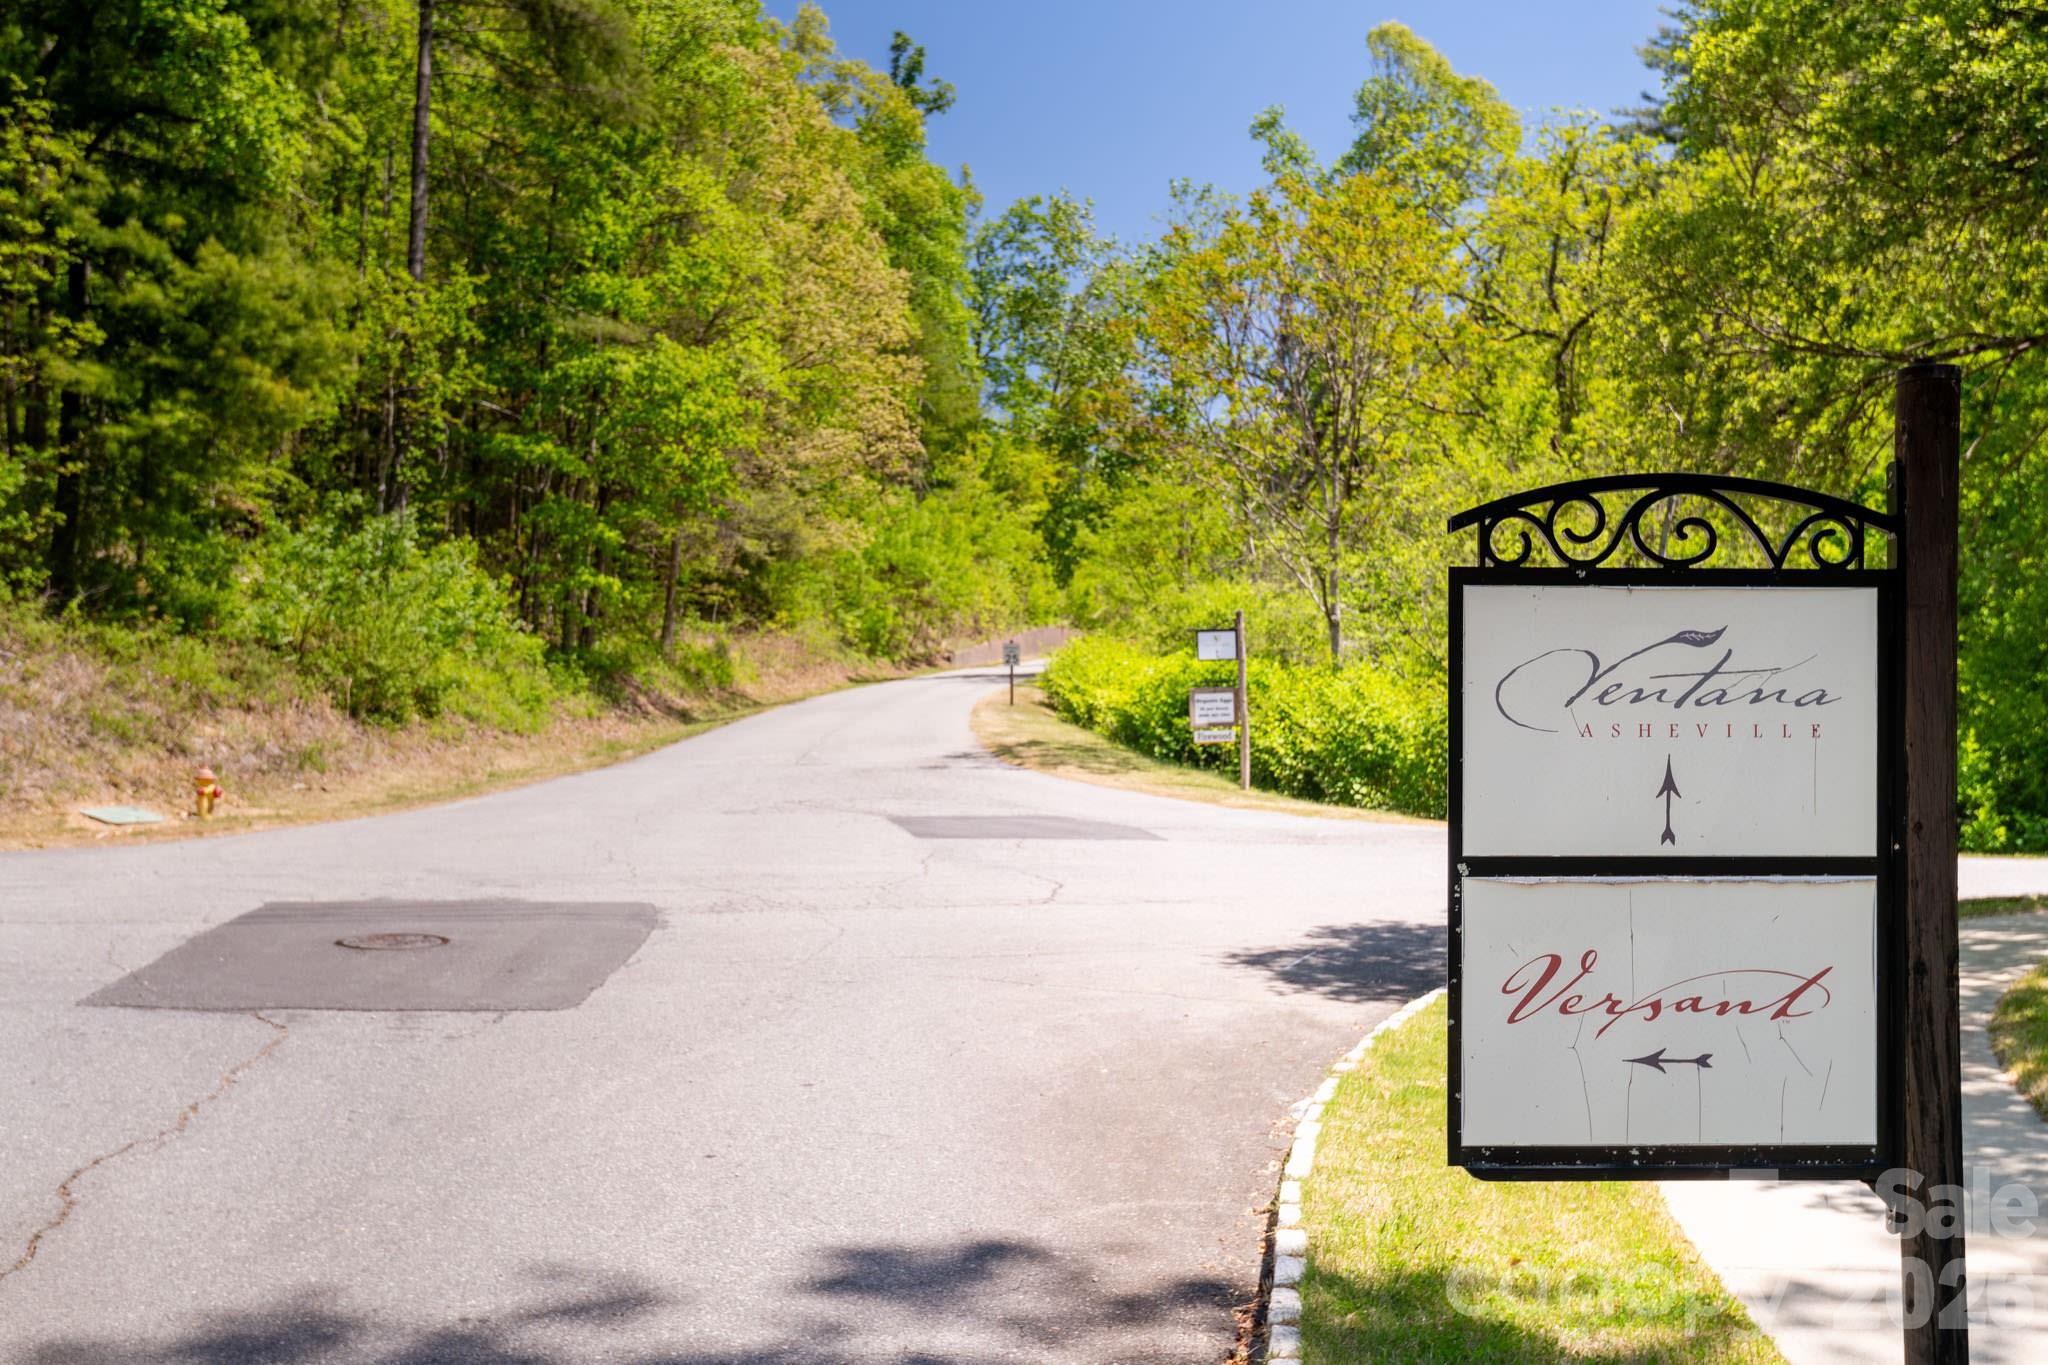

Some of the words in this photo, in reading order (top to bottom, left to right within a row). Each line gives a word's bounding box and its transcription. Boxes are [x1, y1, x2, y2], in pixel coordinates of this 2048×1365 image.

[1495, 625, 1841, 733] Ventana
[1580, 723, 1822, 738] ASHEVILLE
[1502, 949, 1833, 1040] Versant
